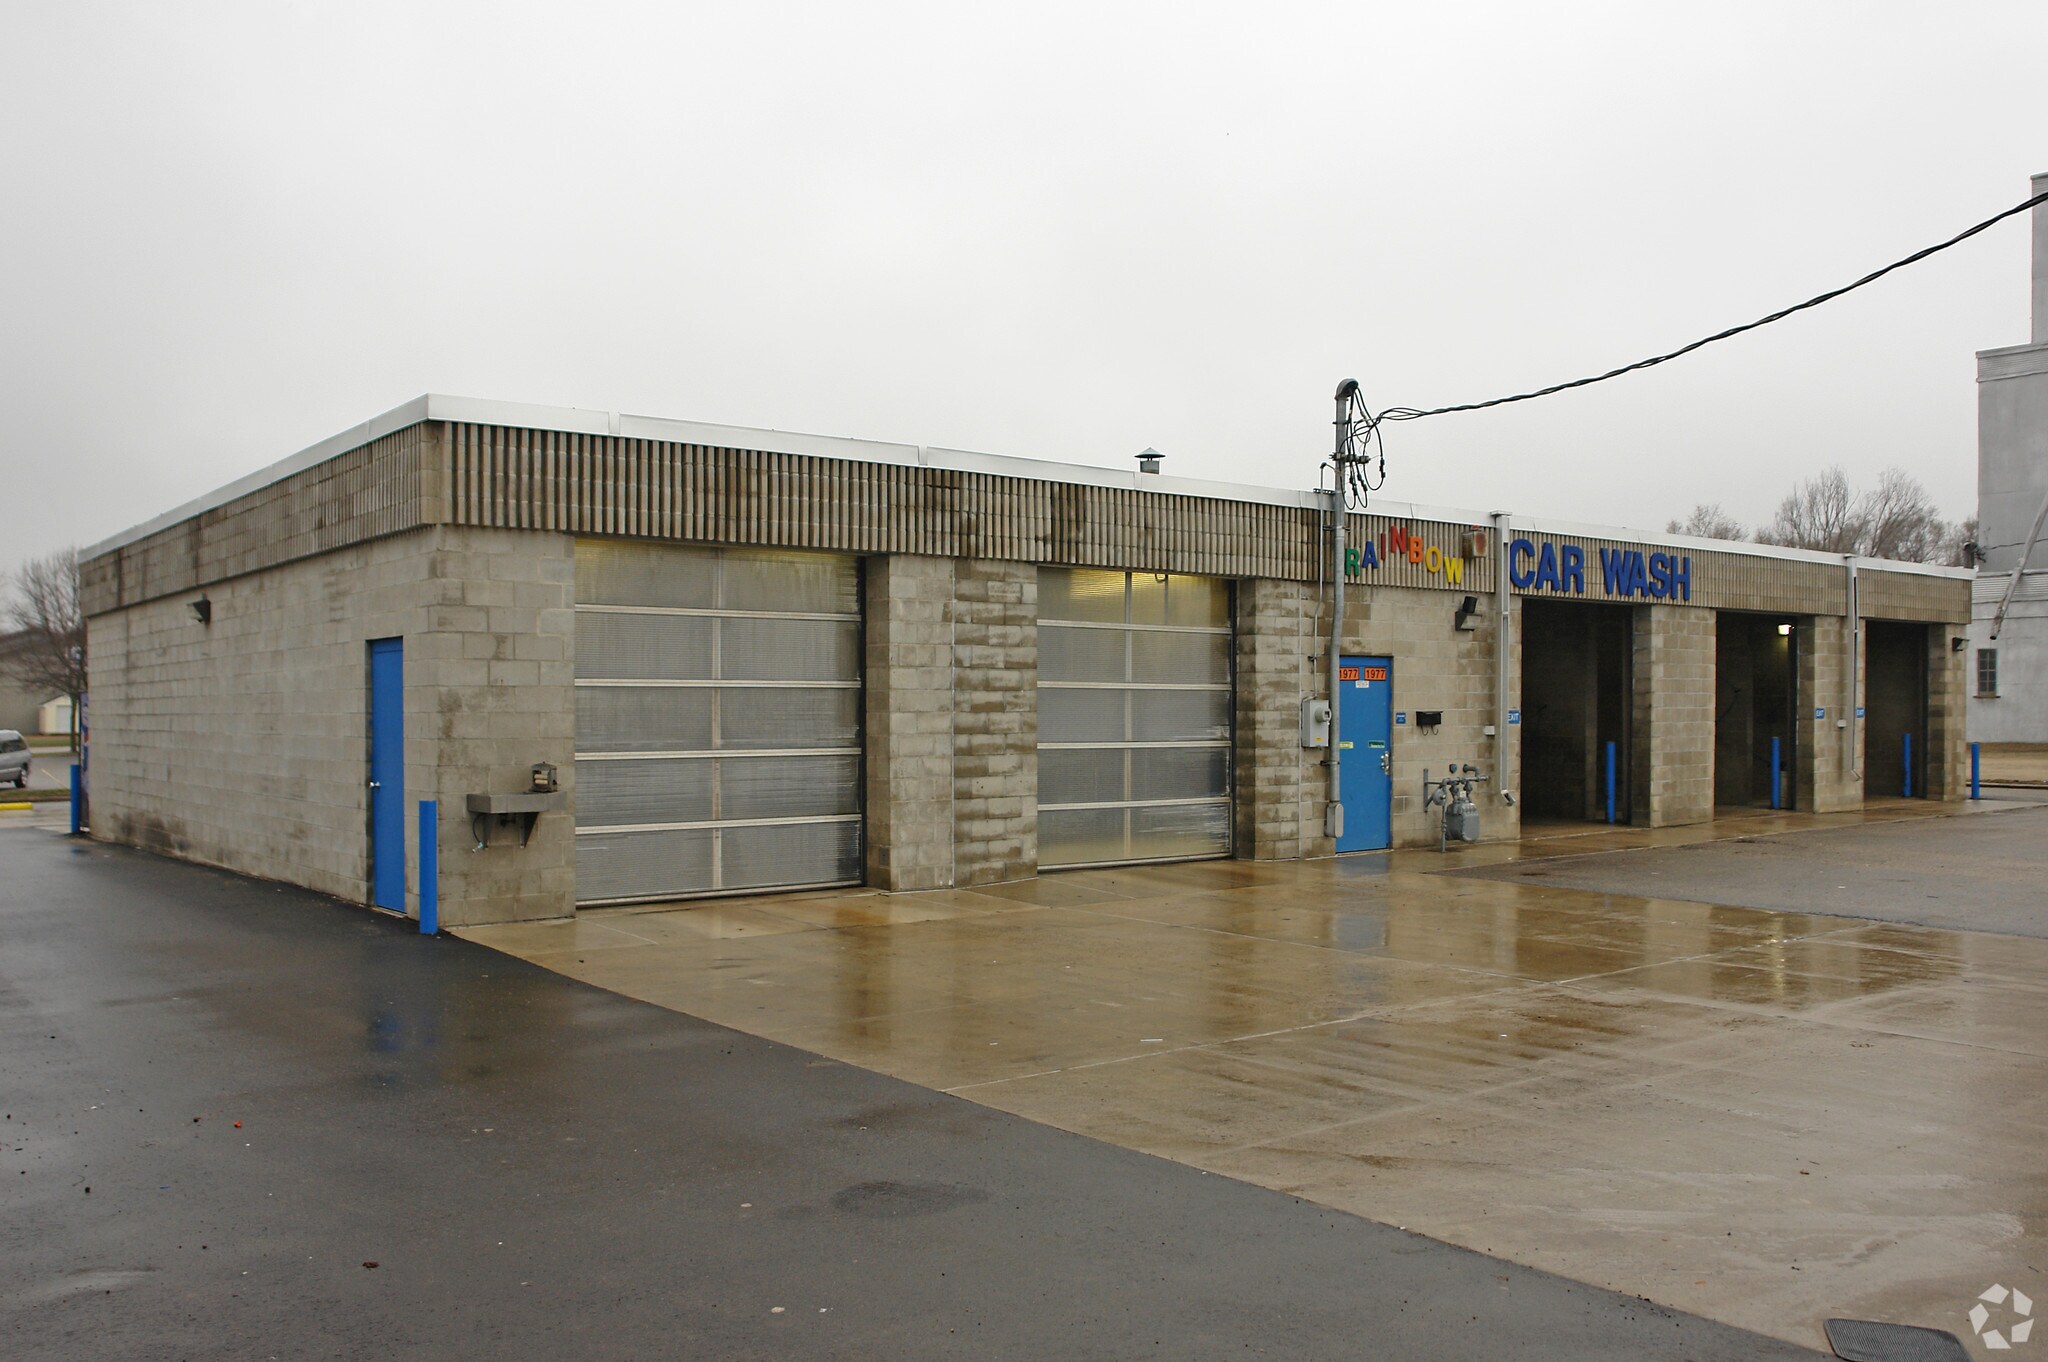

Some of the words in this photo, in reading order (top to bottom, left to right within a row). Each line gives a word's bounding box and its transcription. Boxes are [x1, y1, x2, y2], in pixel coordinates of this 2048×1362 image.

[1345, 526, 1464, 584] RAINBOW
[1510, 538, 1585, 594] CAR
[1600, 548, 1691, 601] WASH
[1366, 669, 1385, 679] 1977
